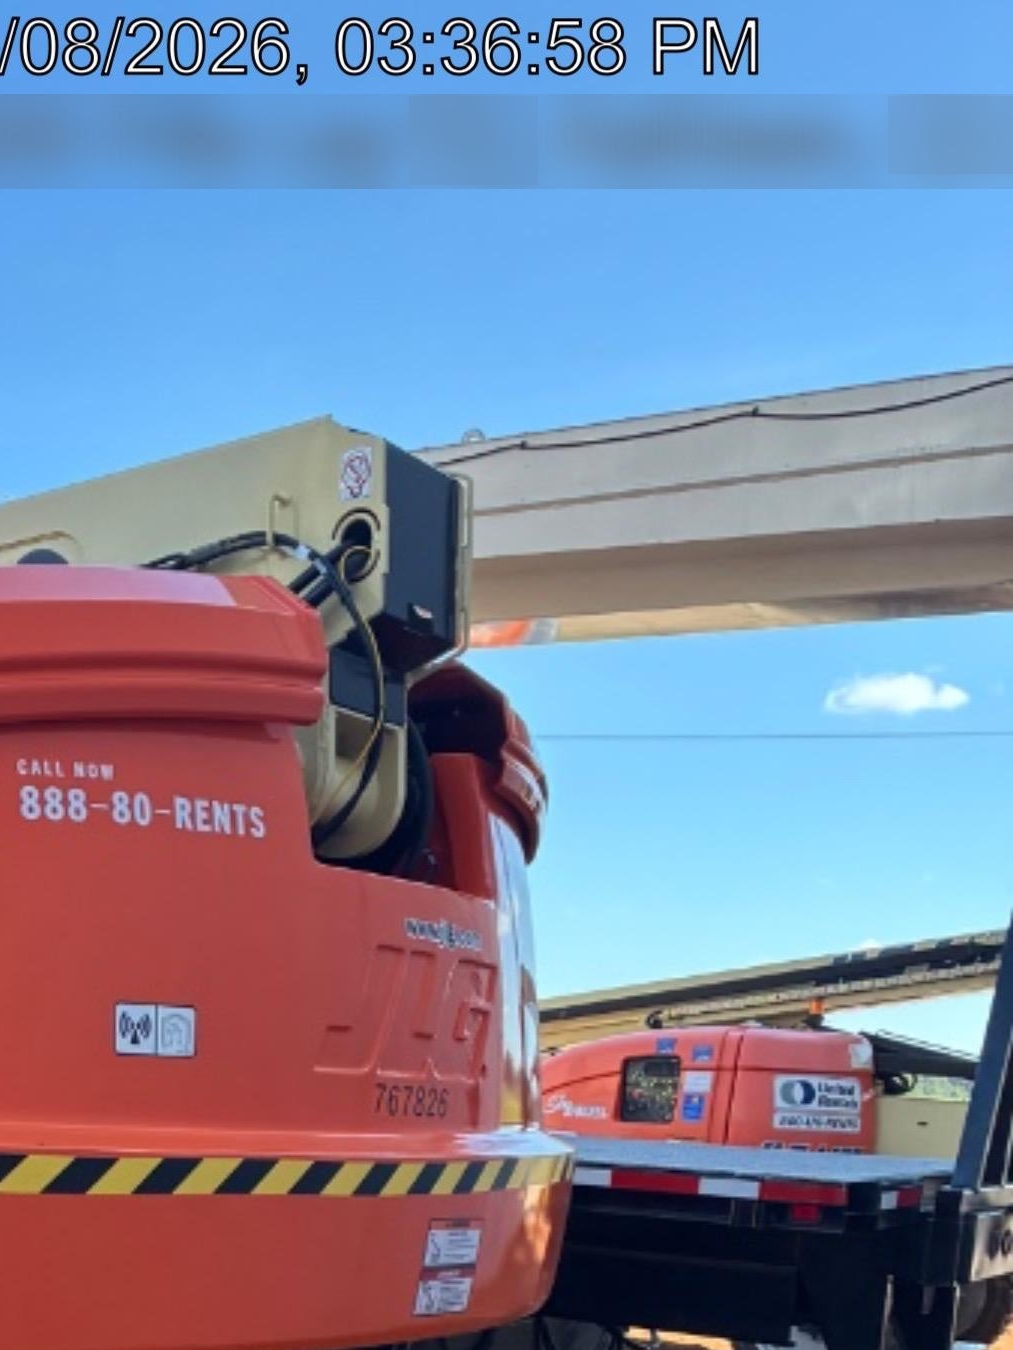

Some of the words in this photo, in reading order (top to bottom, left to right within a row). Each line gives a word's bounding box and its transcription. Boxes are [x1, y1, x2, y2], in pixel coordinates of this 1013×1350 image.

[16, 759, 66, 779] CALL
[73, 761, 115, 781] NOW
[19, 784, 267, 839] 888-80-RENTS
[374, 1082, 450, 1119] 767826
